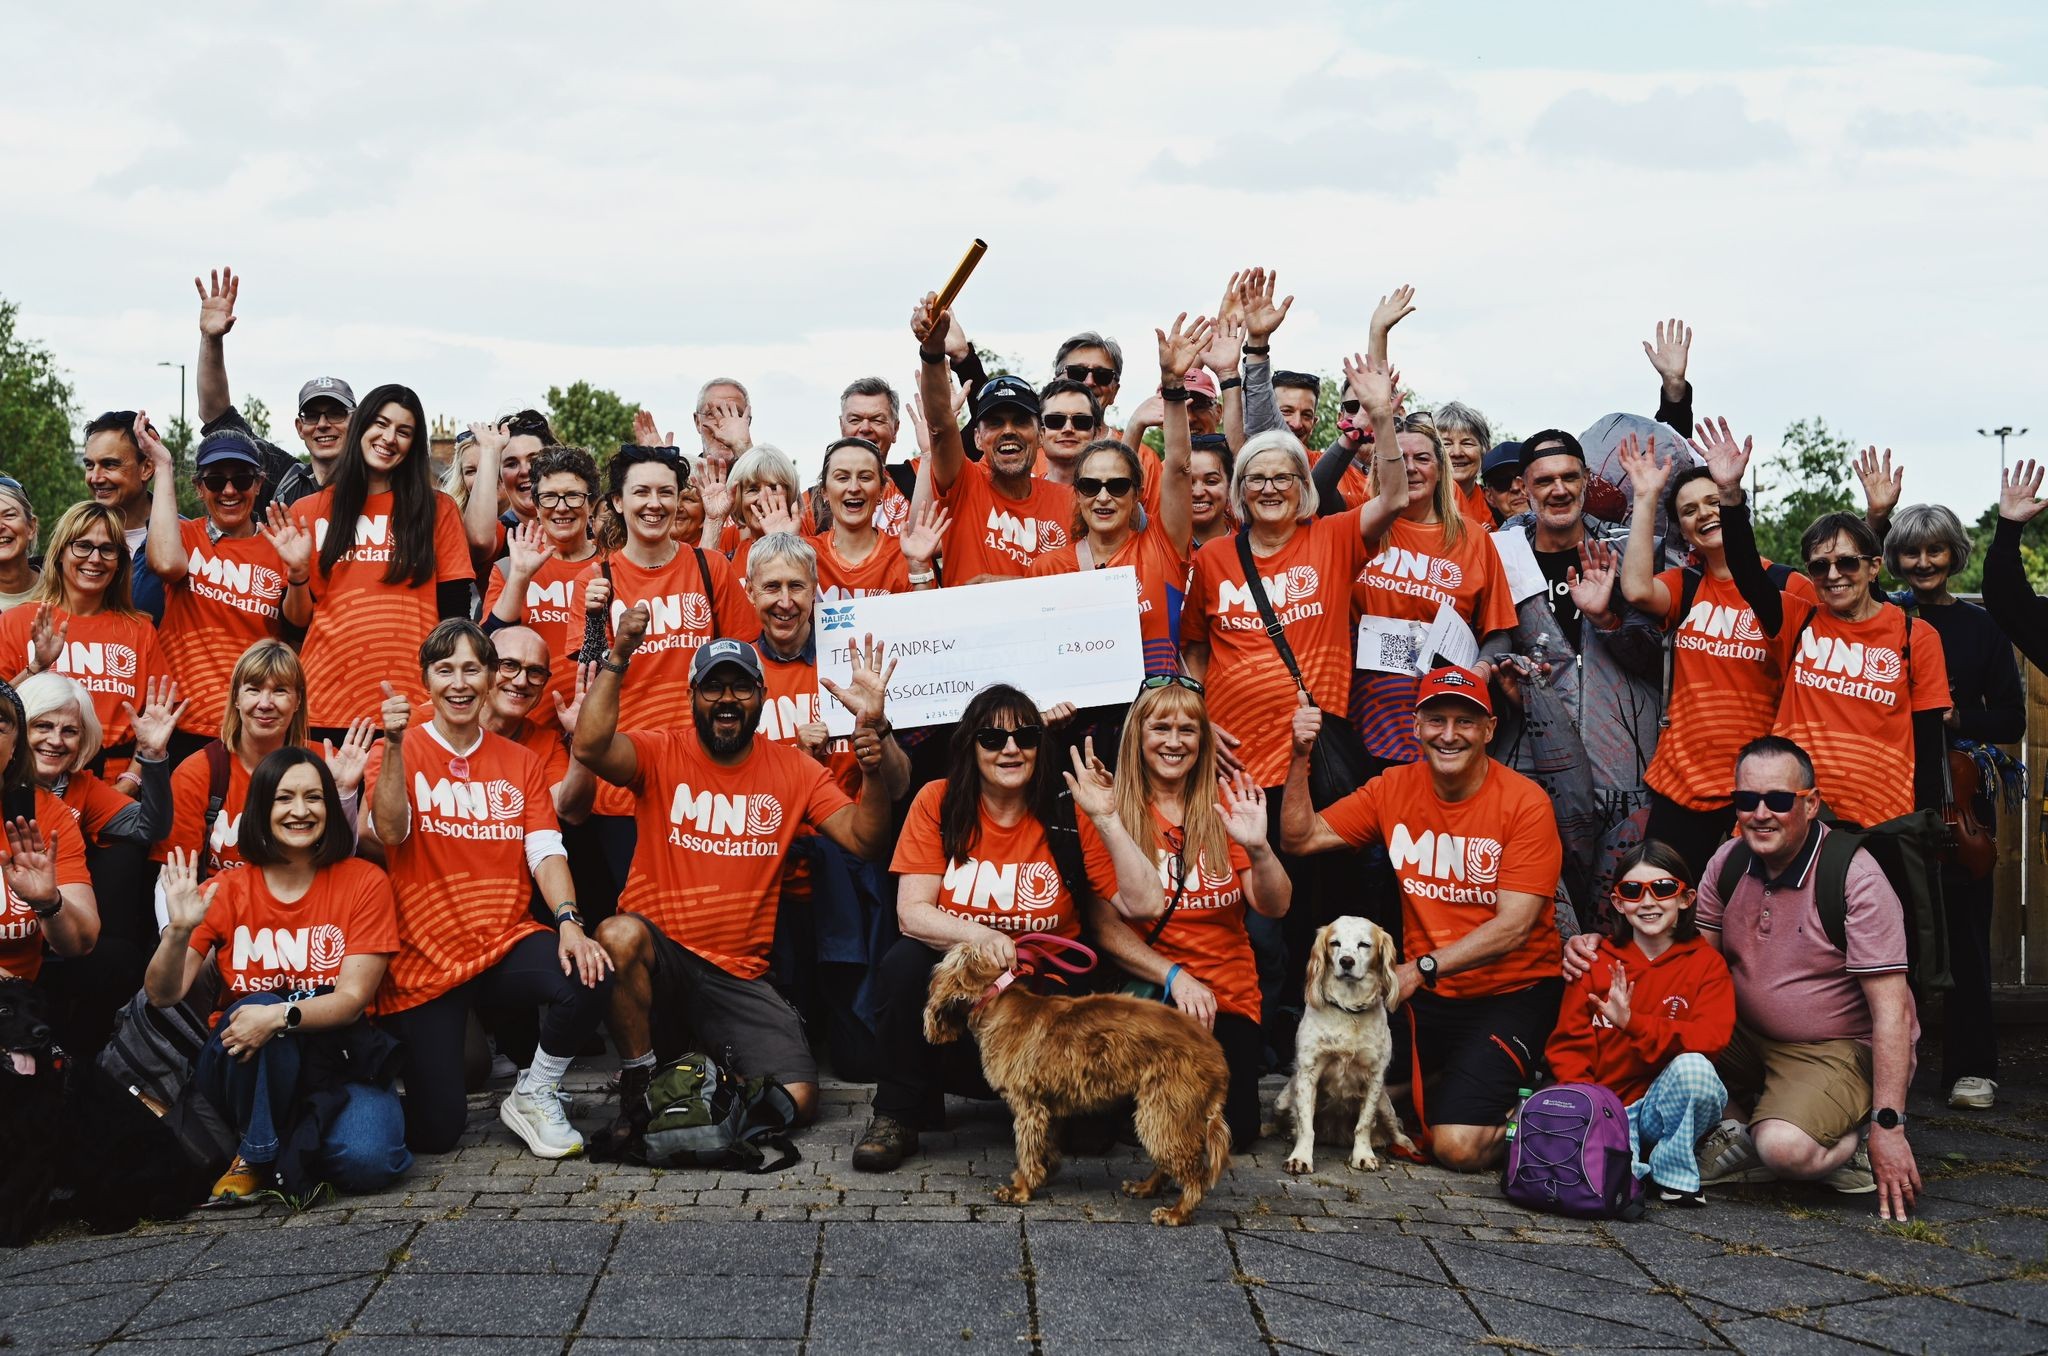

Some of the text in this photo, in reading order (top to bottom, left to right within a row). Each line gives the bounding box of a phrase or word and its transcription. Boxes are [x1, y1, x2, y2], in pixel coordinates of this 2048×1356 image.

[987, 506, 1067, 554] MND
[188, 547, 282, 600] MND
[821, 613, 856, 624] HALIFAX
[1221, 601, 1323, 631] Assoiation
[831, 639, 956, 664] TE ANDREW
[1058, 639, 1115, 655] £28,000
[1795, 626, 1901, 683] MND
[79, 676, 136, 698] ciation
[884, 681, 974, 702] ASSOCIATION
[414, 770, 525, 821] MND
[670, 783, 783, 836] MND
[420, 815, 524, 841] Association
[668, 826, 779, 857] Association
[1388, 823, 1502, 885] MND
[1403, 878, 1498, 905] ssociatio
[232, 924, 346, 972] MND
[230, 973, 338, 993] Assoiatio
